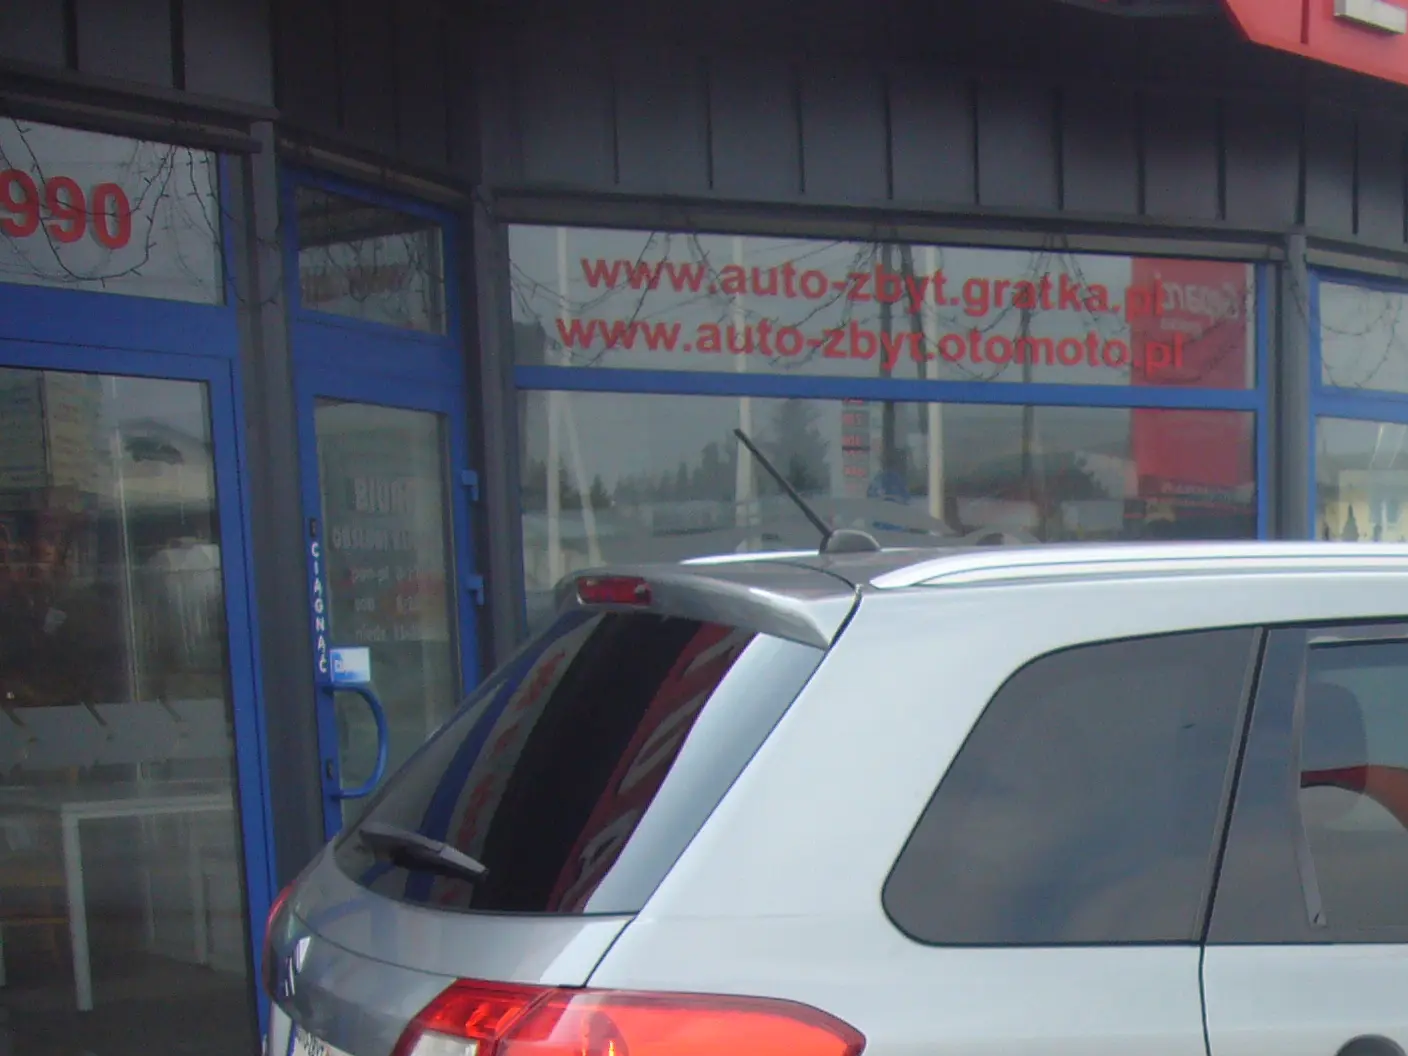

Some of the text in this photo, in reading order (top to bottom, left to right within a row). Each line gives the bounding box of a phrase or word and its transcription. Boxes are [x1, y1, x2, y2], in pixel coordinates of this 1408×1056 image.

[0, 170, 130, 249] 990
[581, 258, 1164, 323] www.auto-zbyt.gratka.pl
[556, 317, 1184, 376] www.auto-zbyt.otomoto.pl
